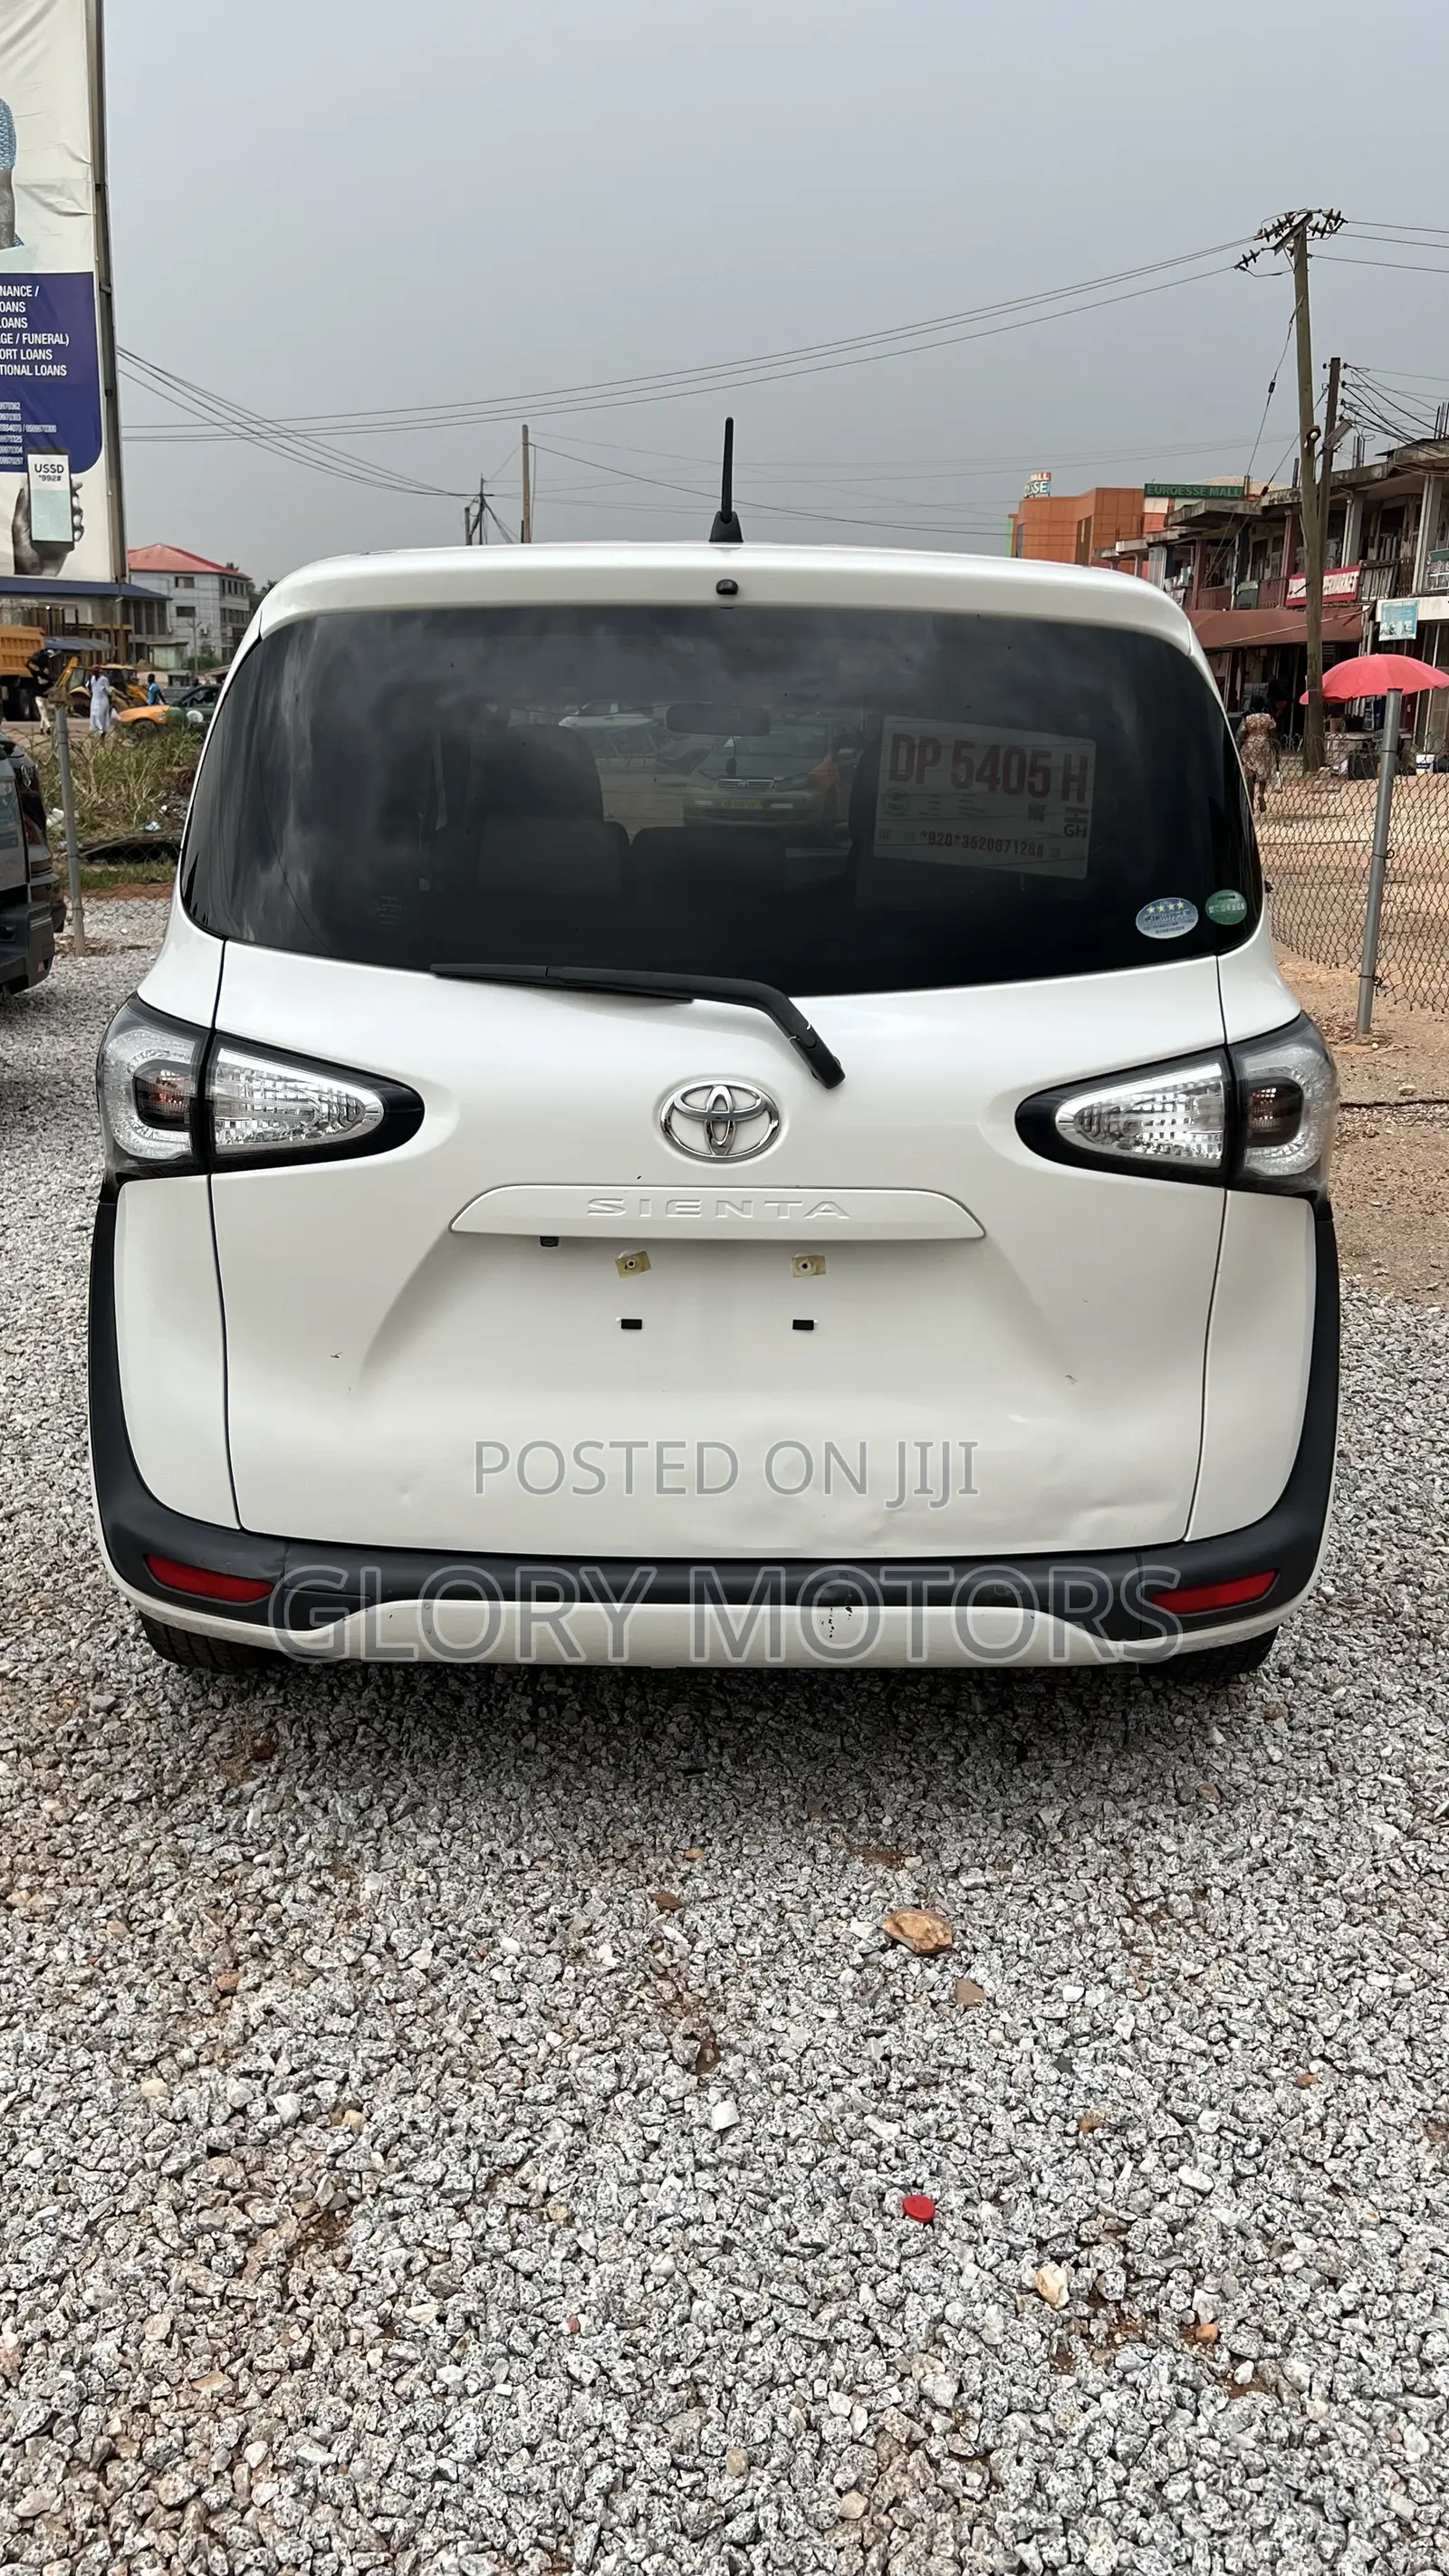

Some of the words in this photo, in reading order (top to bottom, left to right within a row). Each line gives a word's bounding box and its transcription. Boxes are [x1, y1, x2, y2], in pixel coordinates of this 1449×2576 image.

[0, 317, 28, 329] OANS
[0, 332, 14, 344] GE
[22, 332, 70, 347] FUNERAL)
[20, 349, 53, 360] LOANS
[34, 364, 67, 377] LOANS
[34, 464, 64, 474] USSD
[1209, 487, 1242, 498] MALL
[888, 733, 943, 784] DP
[951, 739, 1052, 800] 5405
[1060, 753, 1088, 804] H
[1063, 823, 1087, 839] GH
[587, 1197, 851, 1221] SIENTA
